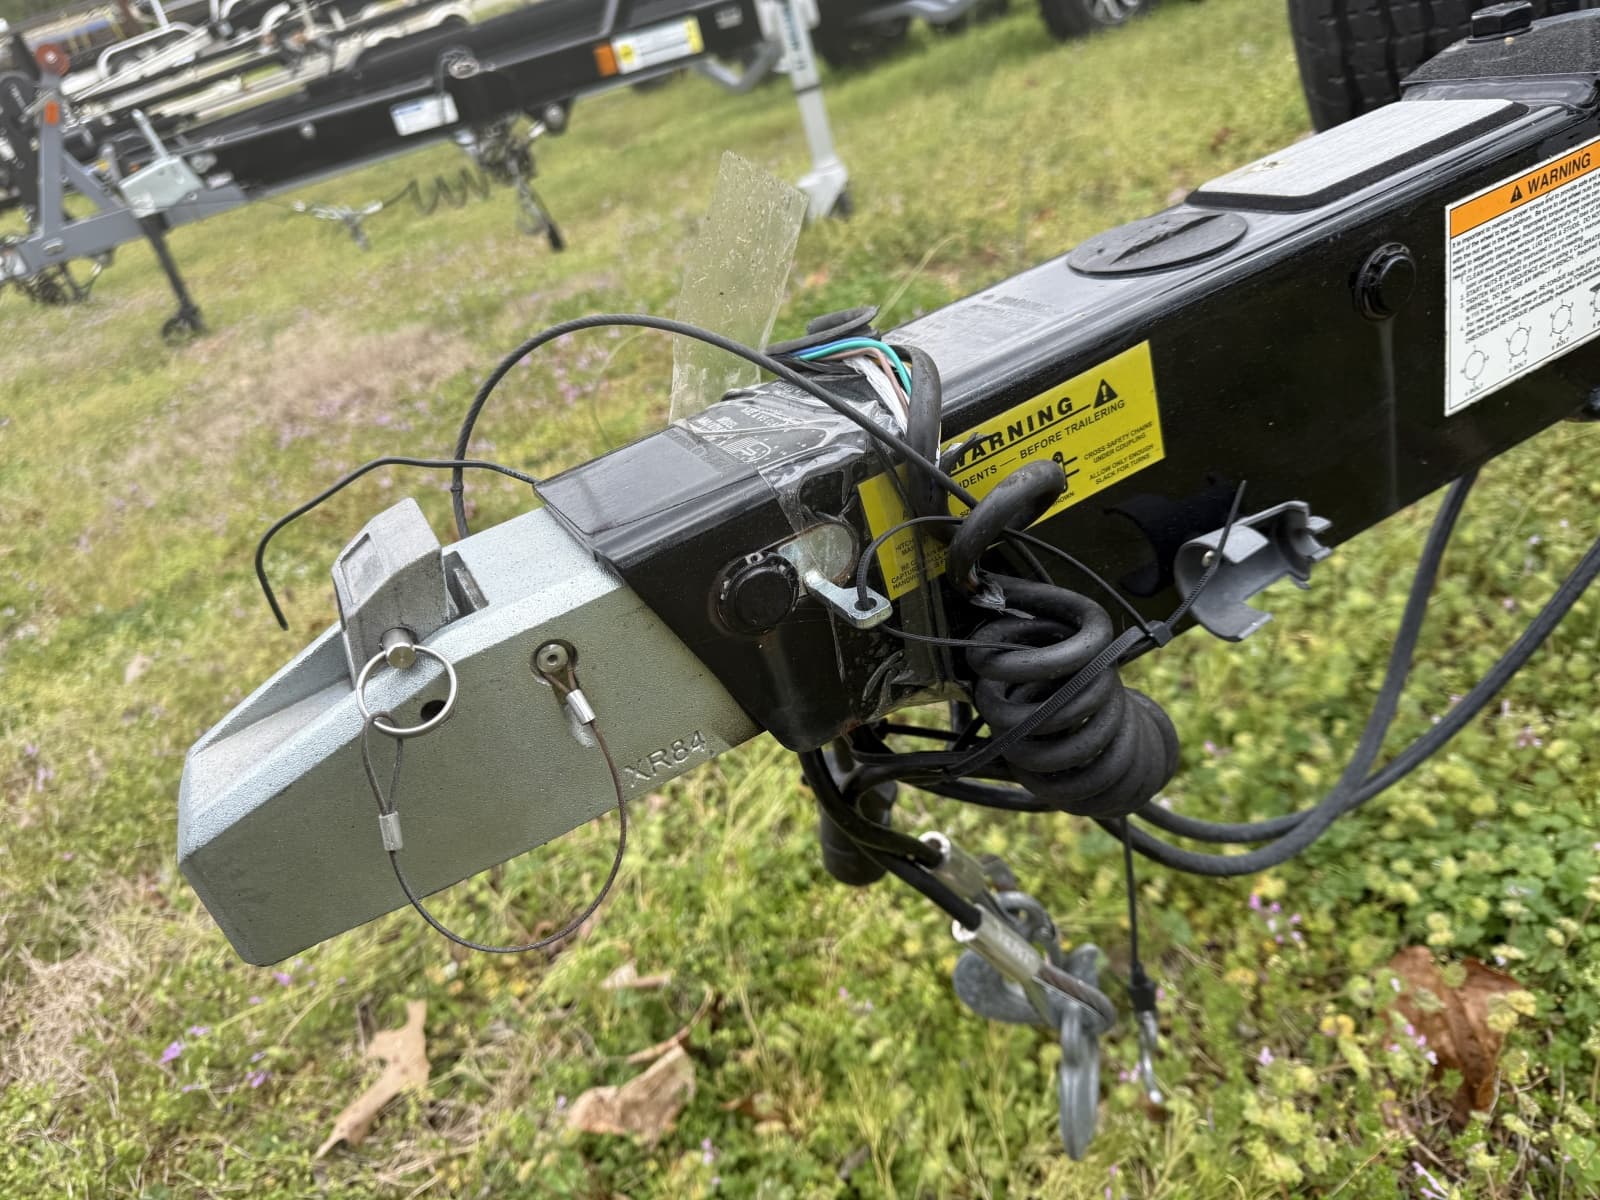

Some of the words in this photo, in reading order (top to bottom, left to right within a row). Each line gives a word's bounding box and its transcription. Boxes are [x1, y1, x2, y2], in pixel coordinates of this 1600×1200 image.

[1527, 151, 1590, 195] WARNING
[1462, 228, 1484, 244] important
[1512, 207, 1527, 219] proper
[1560, 183, 1577, 196] provide
[1479, 232, 1493, 243] wheel
[1568, 189, 1581, 200] wheel
[1019, 430, 1062, 459] BEFORE
[1064, 398, 1125, 436] TRAILERING
[1083, 445, 1105, 460] CROSS
[1105, 432, 1129, 449] SAFETY
[1130, 421, 1152, 436] CHAINS
[1092, 447, 1114, 463] UNDER
[1115, 431, 1146, 452] COUPLING
[1088, 465, 1111, 481] ALLOW
[1111, 456, 1128, 469] ONLY
[1128, 443, 1153, 460] ENOUGH
[1095, 470, 1115, 485] SLACK
[1116, 463, 1129, 474] FOR
[1130, 452, 1150, 467] TURNS
[623, 730, 706, 788] XR84
